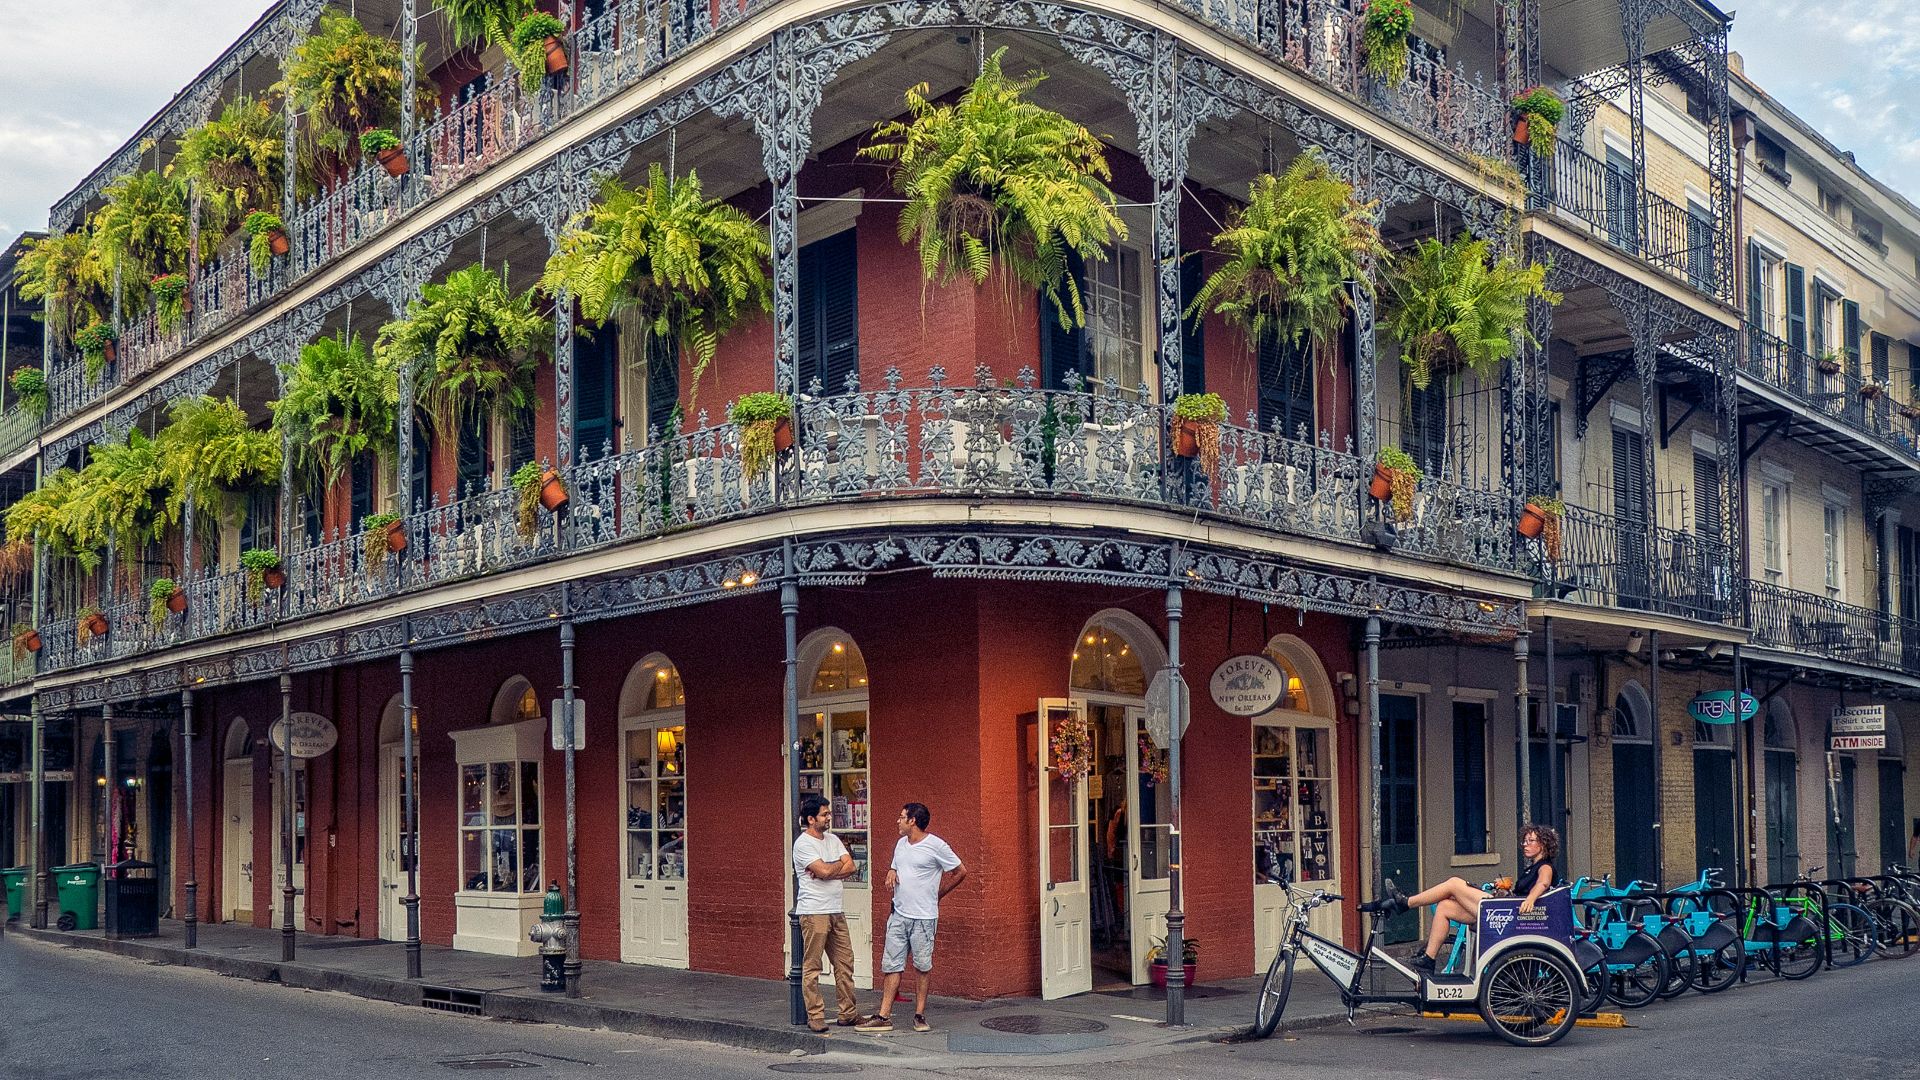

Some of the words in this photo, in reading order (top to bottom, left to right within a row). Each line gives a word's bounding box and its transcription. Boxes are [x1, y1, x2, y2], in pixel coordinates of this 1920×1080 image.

[1219, 660, 1272, 682] FOREVER
[1237, 694, 1272, 702] ORLEANS
[1834, 707, 1882, 717] Discount
[1833, 738, 1859, 748] ATM
[1860, 737, 1884, 747] INSIDE
[1313, 942, 1328, 952] NEED
[1437, 988, 1463, 999] PC-22
